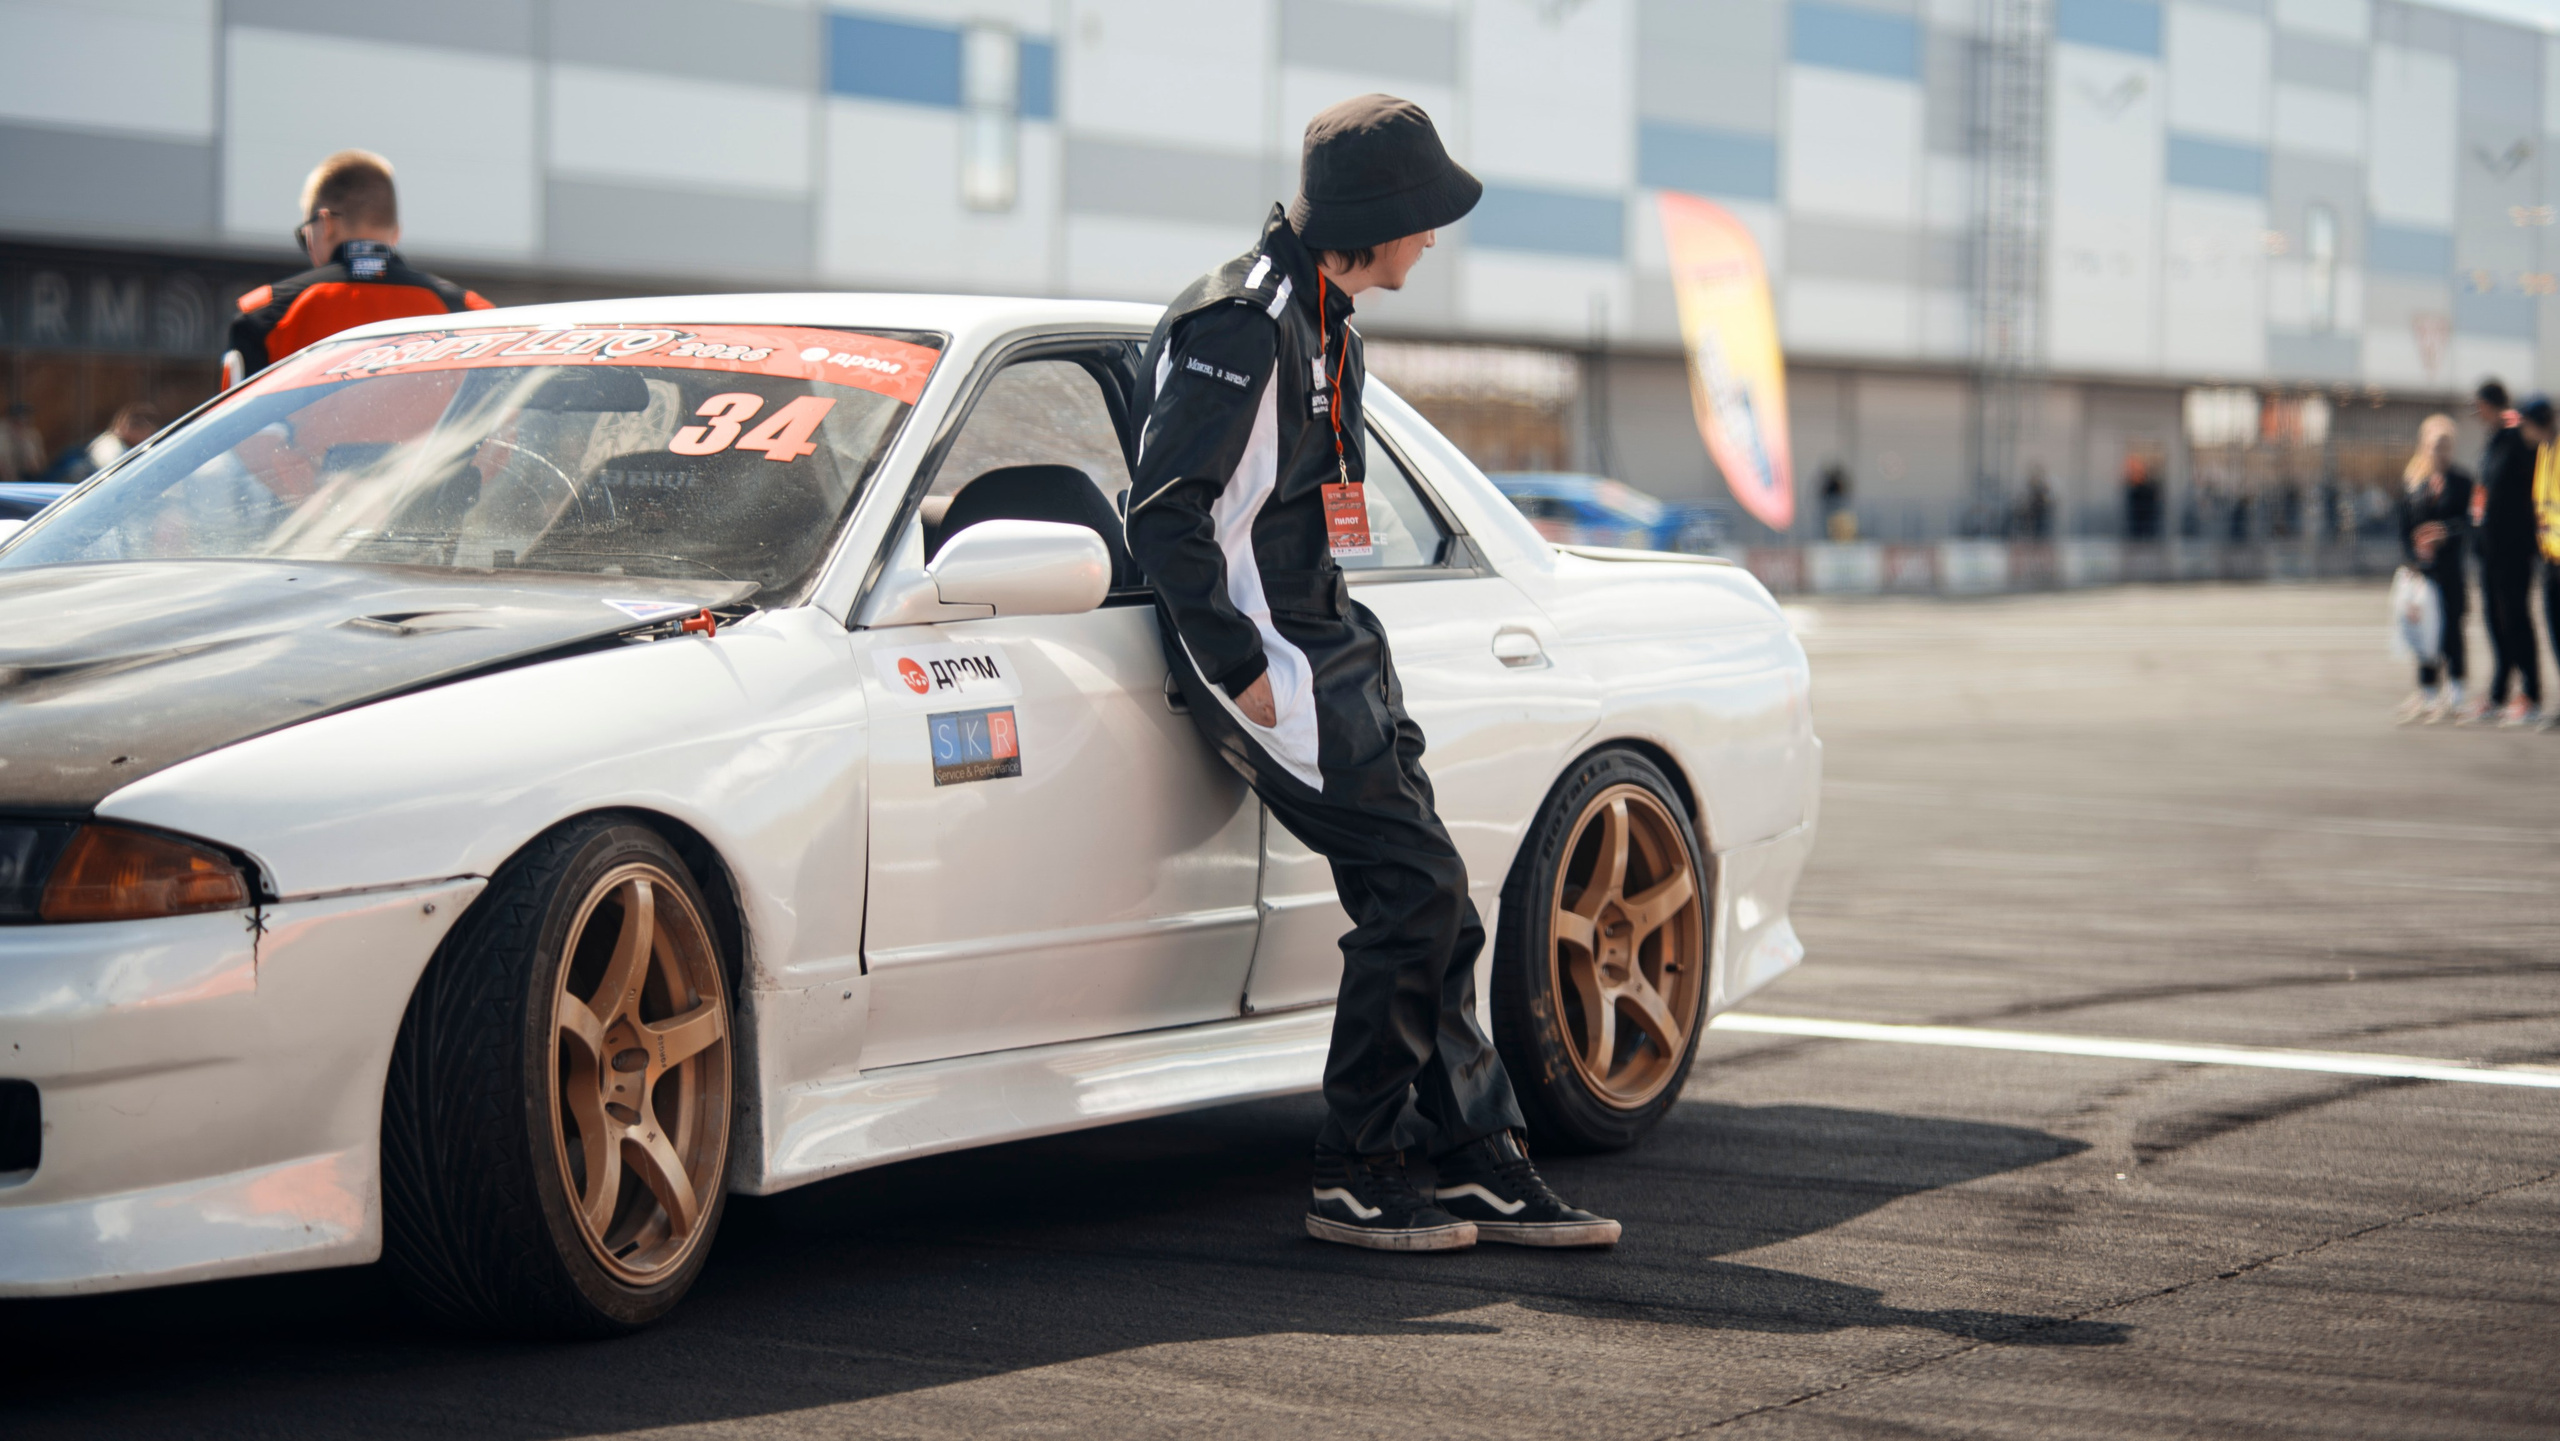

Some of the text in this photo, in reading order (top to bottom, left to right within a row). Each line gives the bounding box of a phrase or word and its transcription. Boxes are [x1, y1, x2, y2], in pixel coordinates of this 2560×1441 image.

[323, 329, 774, 374] DRIFT LETO 2026
[1217, 369, 1223, 378] а
[669, 392, 837, 463] 34
[1334, 516, 1359, 526] ПИЛОТ
[938, 718, 1012, 760] SKR
[936, 769, 965, 782] Service
[966, 766, 974, 778] &
